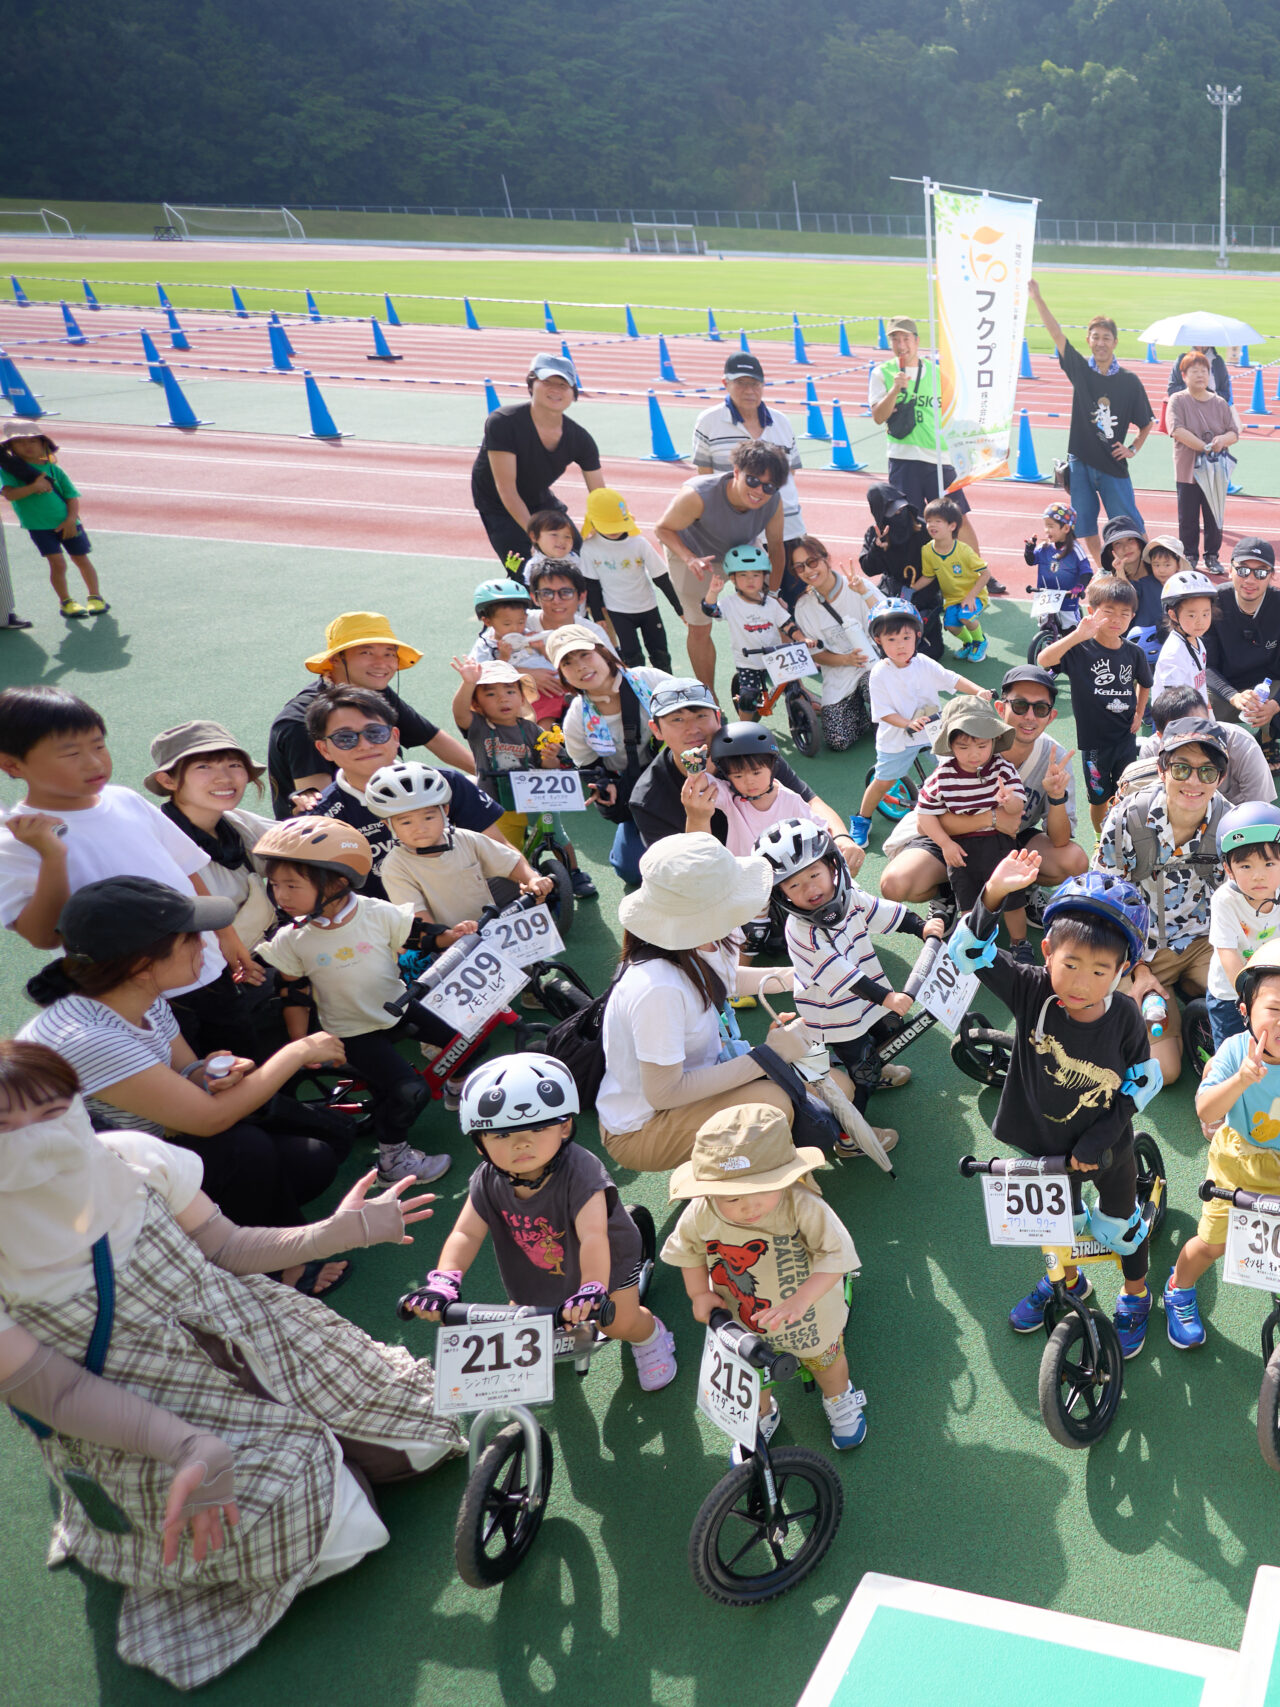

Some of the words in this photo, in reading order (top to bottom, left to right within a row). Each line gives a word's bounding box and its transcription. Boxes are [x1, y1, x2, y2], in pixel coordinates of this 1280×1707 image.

[975, 289, 997, 388] フクプロ
[528, 775, 577, 795] 220
[495, 912, 550, 950] 209
[444, 952, 503, 1007] 309
[433, 1025, 486, 1079] STRIDE
[879, 1013, 934, 1062] STRIDER
[470, 1118, 493, 1129] bern
[1005, 1182, 1066, 1216] 503
[461, 1327, 542, 1375] 213
[464, 1374, 501, 1391] シンカワ
[710, 1350, 753, 1410] 215
